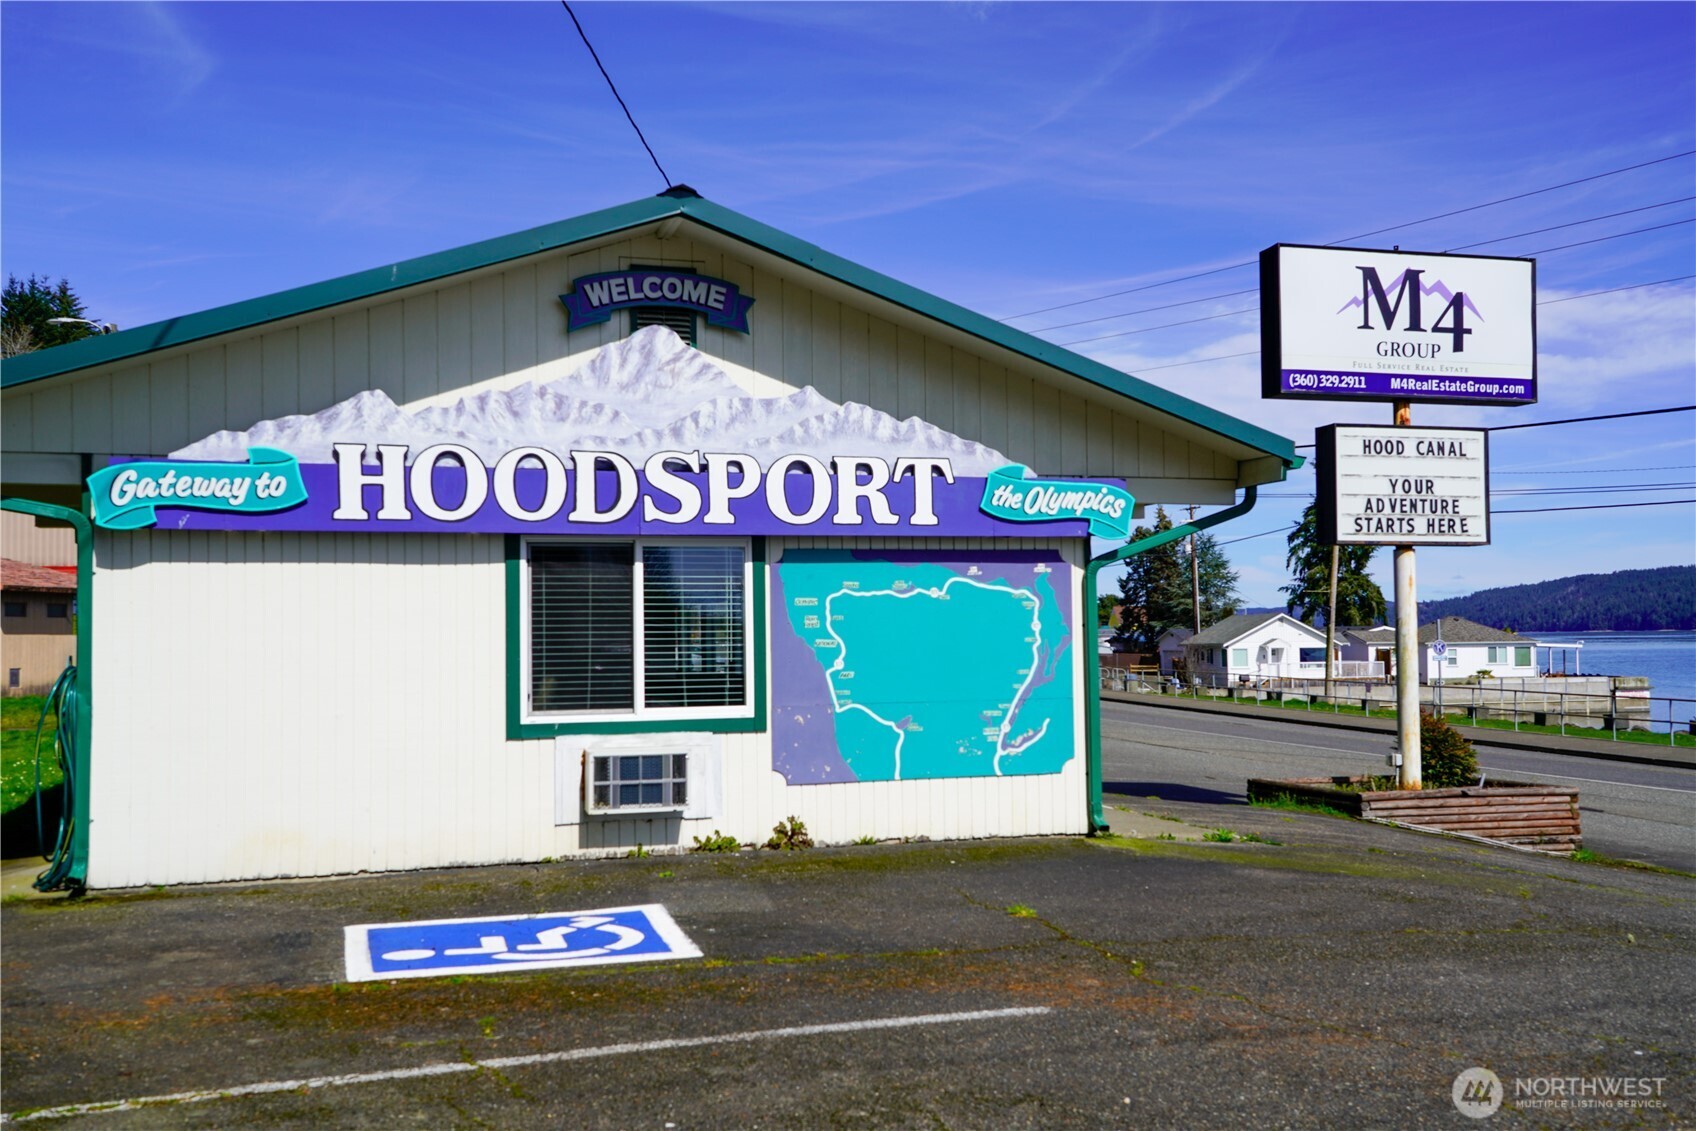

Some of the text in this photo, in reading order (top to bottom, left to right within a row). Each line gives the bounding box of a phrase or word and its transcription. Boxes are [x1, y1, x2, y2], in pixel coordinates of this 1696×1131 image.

[582, 276, 728, 311] WELCOME
[1355, 265, 1472, 353] M4
[1376, 341, 1441, 359] GROUP
[1289, 373, 1525, 396] (360) 329.2911 M4RealEstateGroup.com
[1362, 439, 1468, 457] HOOD CANAL
[109, 468, 288, 507] Gateway to
[332, 442, 955, 527] HOODSPORT
[1388, 478, 1435, 495] YOUR
[991, 483, 1126, 521] the Olympics
[1364, 498, 1460, 515] ADVENTURE
[1354, 517, 1470, 534] STARTS HERE
